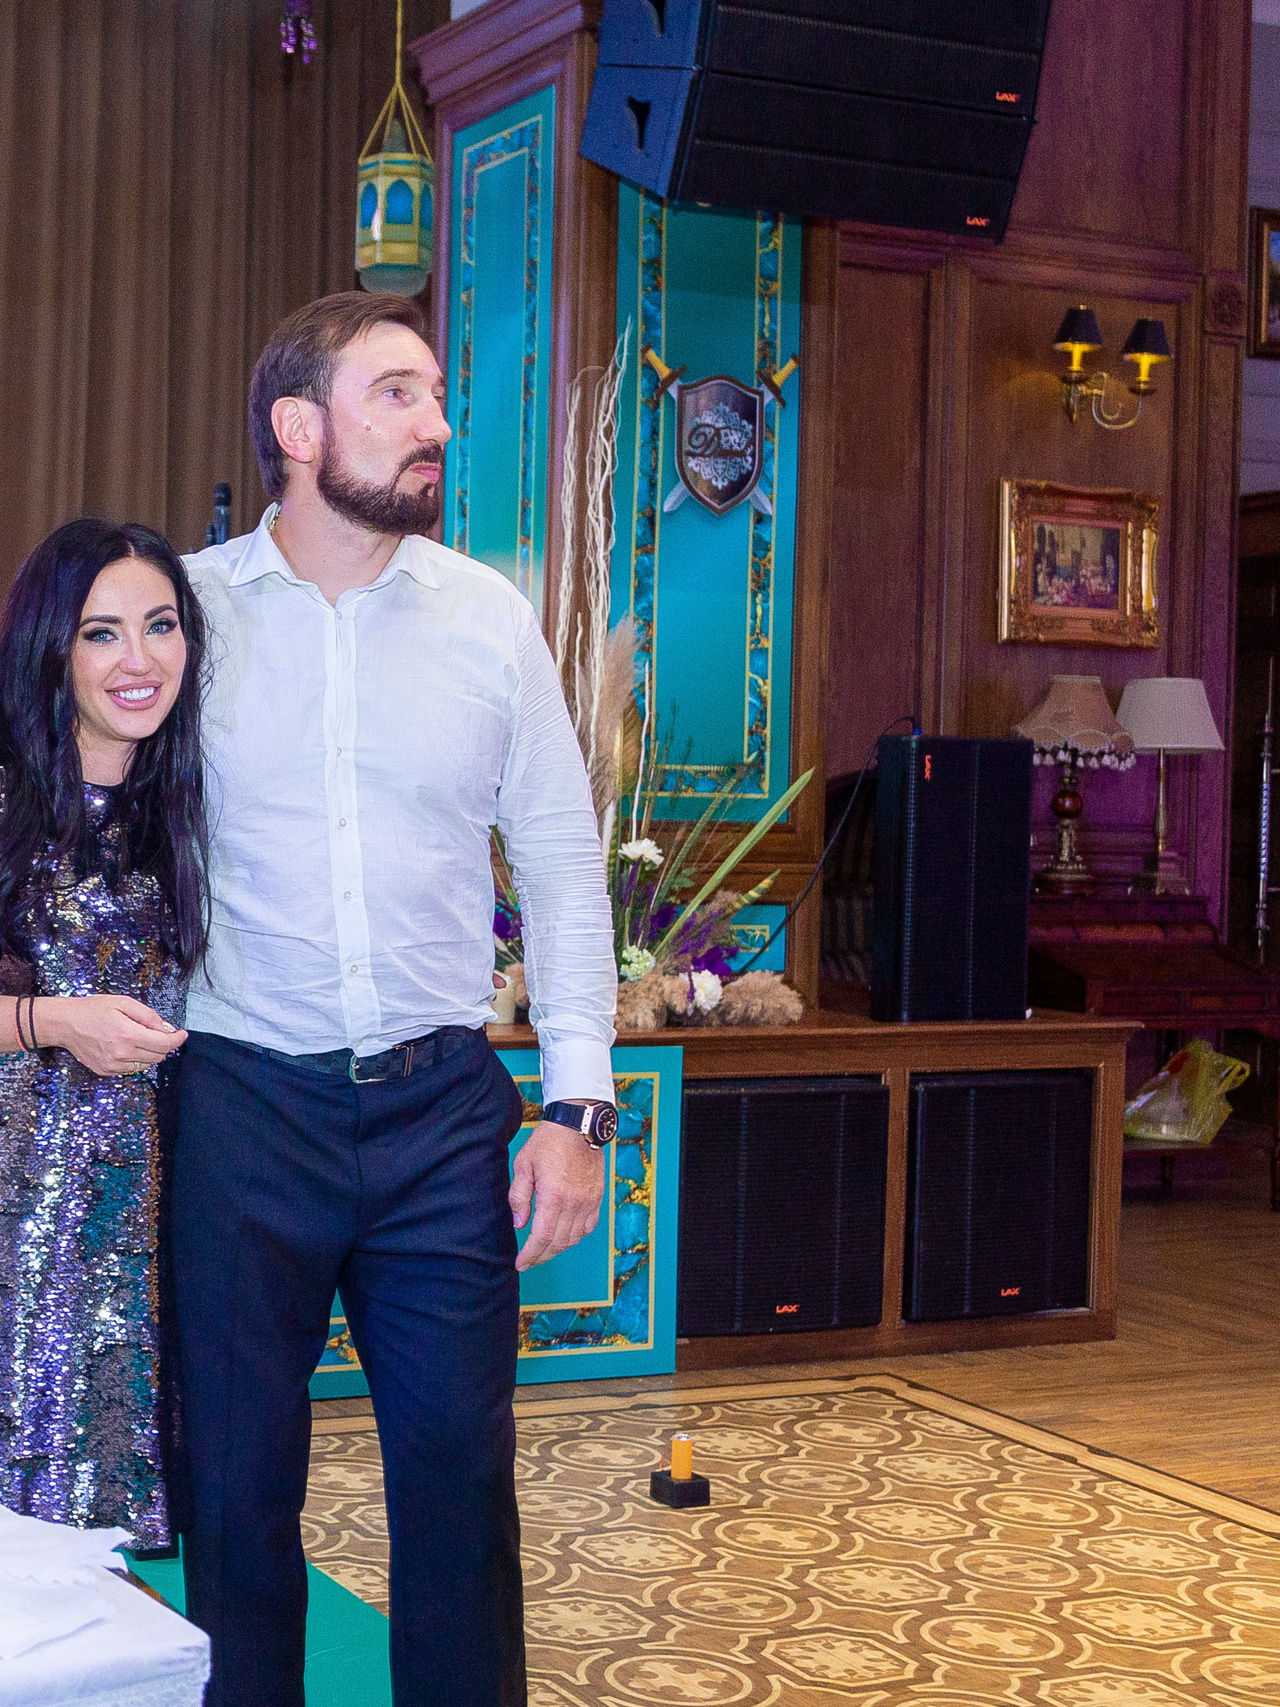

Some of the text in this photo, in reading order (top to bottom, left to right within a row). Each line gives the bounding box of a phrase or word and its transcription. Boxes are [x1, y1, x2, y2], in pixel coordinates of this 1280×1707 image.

[995, 91, 1018, 103] LAX
[966, 215, 988, 227] LAX
[924, 754, 932, 780] LAX
[1001, 1287, 1020, 1297] LAX
[775, 1304, 798, 1314] LAX
